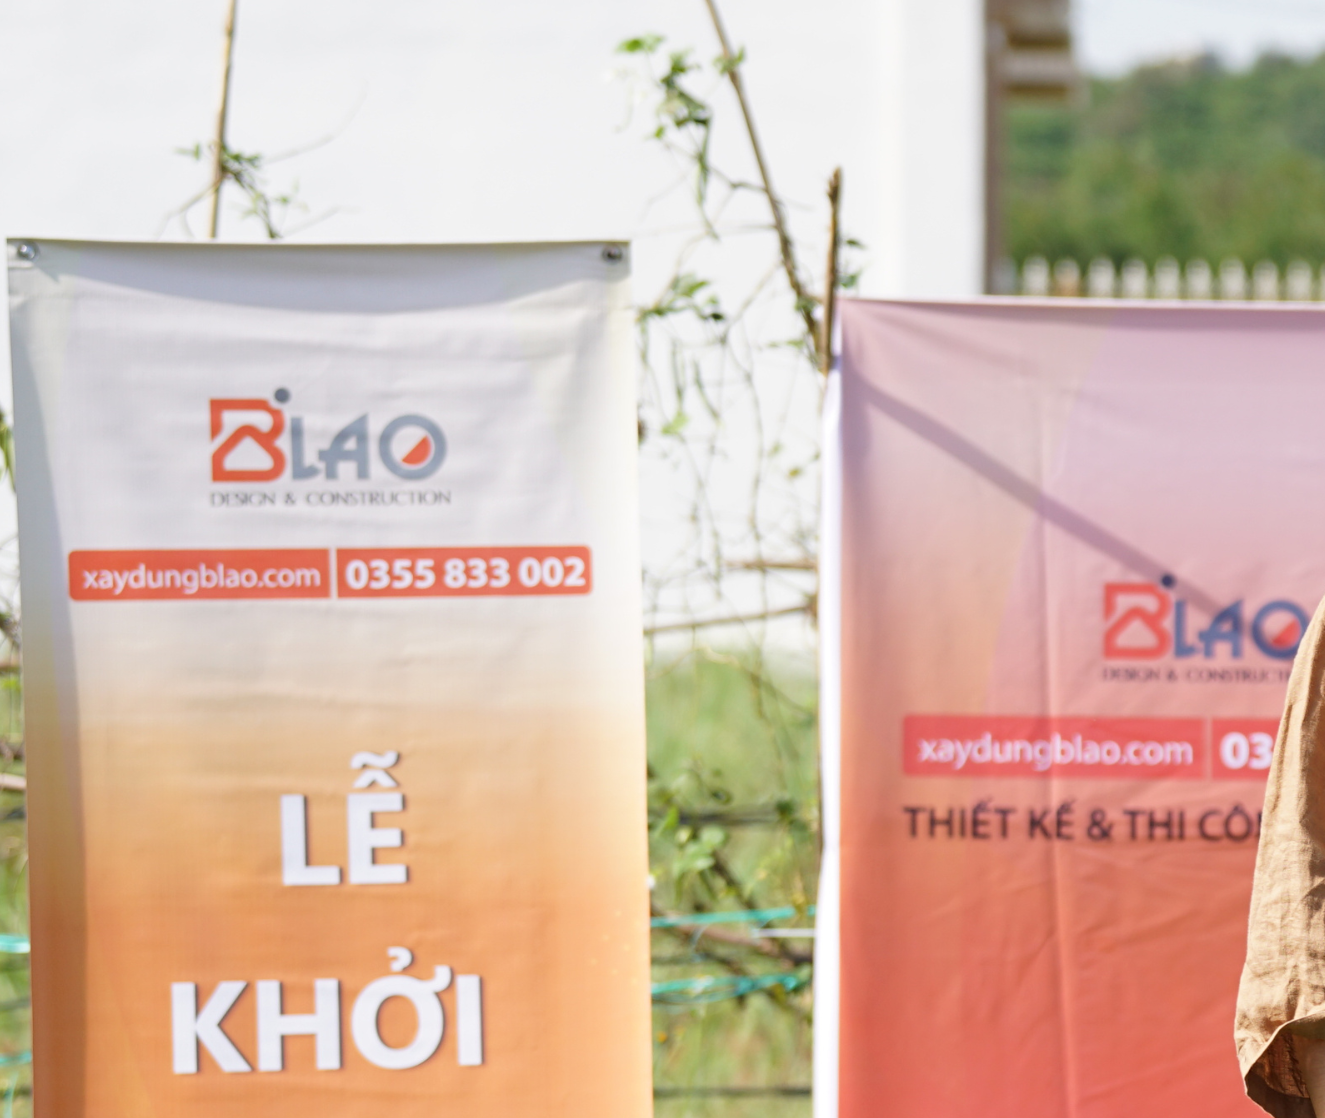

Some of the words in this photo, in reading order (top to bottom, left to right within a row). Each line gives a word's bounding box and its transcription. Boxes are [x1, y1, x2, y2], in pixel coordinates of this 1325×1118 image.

[210, 491, 276, 508] DESIGN
[284, 491, 297, 506] &
[305, 489, 452, 507] CONSTRUCTION
[82, 562, 322, 596] xaydungblao.com
[345, 559, 436, 590] 0355
[444, 559, 511, 588] 833
[518, 557, 587, 588] 002
[1186, 666, 1291, 684] CONSTRUCTI
[917, 731, 1194, 772] xaydungblao.com
[1219, 731, 1274, 770] 03
[281, 750, 408, 886] LỄ
[903, 797, 1015, 840] THIẾT
[1027, 799, 1075, 841] KẾ
[1086, 808, 1112, 842] &
[1123, 809, 1186, 841] THI
[1199, 804, 1262, 843] CÔ
[170, 946, 484, 1075] KHỞI
